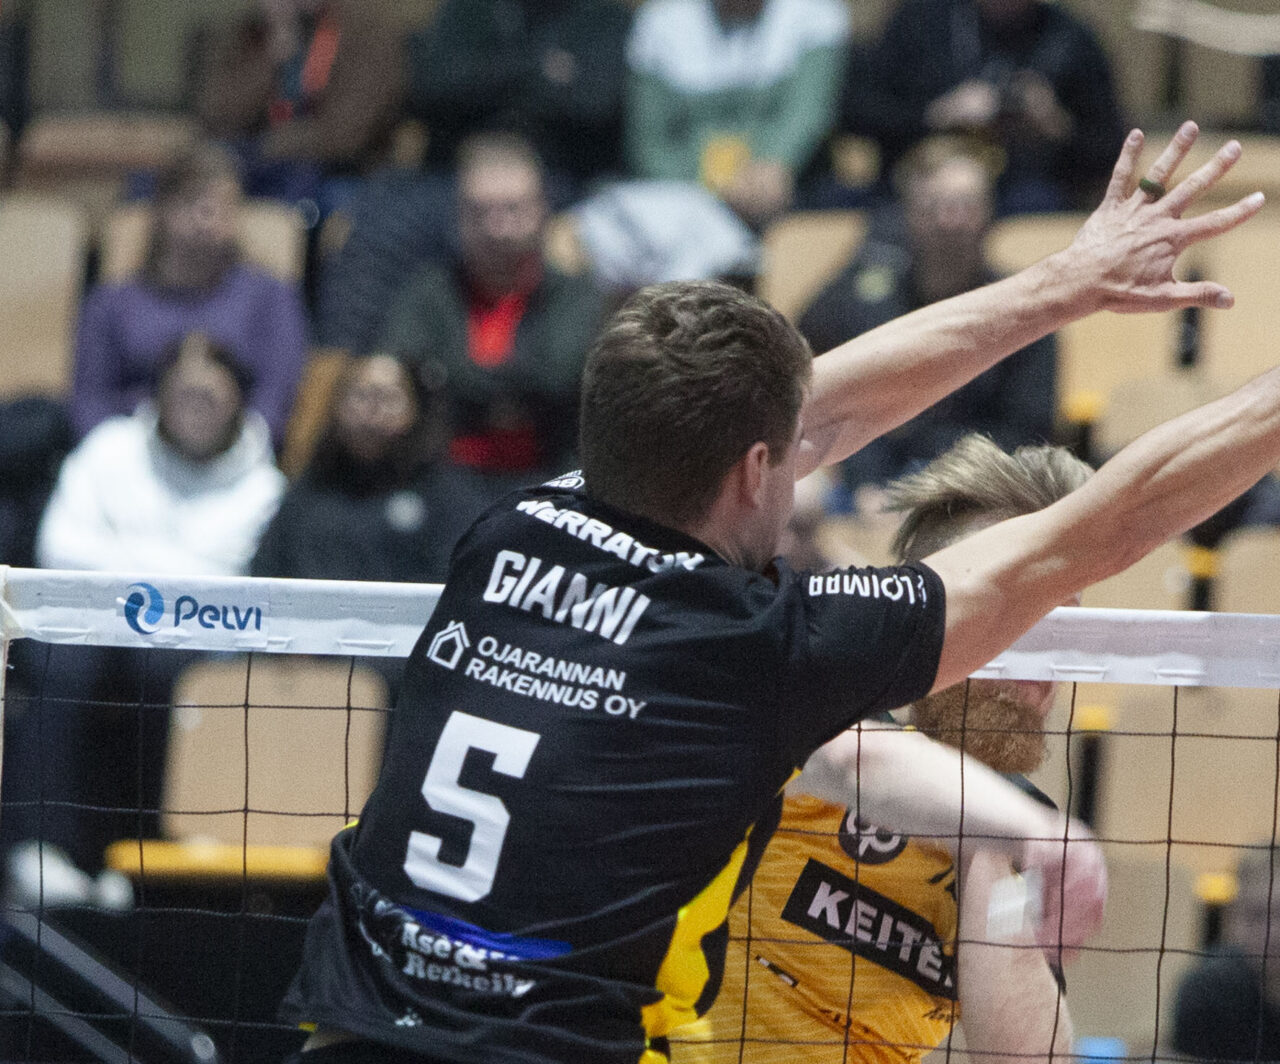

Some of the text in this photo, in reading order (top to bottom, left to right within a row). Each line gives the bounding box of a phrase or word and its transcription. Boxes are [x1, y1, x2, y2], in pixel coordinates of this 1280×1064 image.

[483, 548, 651, 646] GIANNI
[464, 657, 648, 719] RAKENNUS OY
[477, 636, 627, 692] OJARANNAN
[403, 710, 542, 904] 5
[807, 881, 953, 989] KEITE
